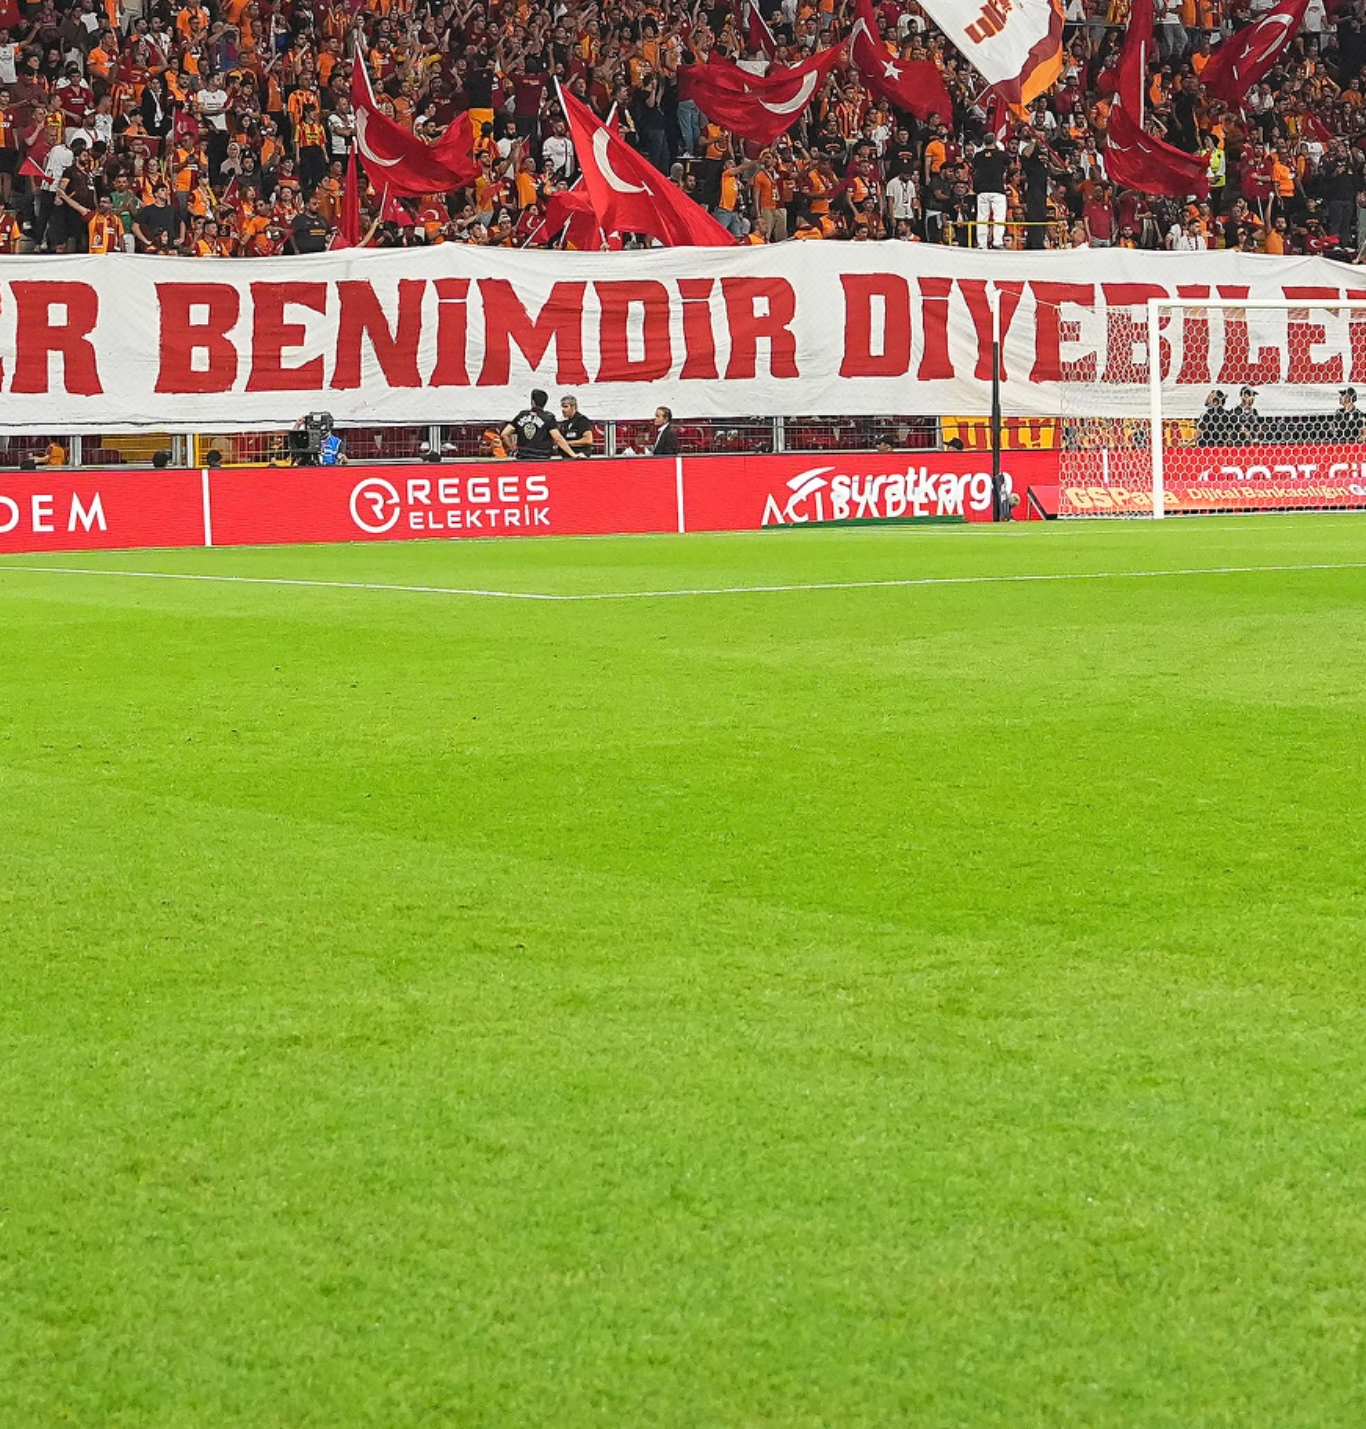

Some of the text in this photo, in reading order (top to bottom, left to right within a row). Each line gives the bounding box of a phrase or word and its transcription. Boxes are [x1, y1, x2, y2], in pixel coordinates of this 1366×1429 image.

[154, 277, 800, 394] BENİMDİR
[407, 475, 550, 505] REGES
[408, 504, 551, 529] ELEKTRİK
